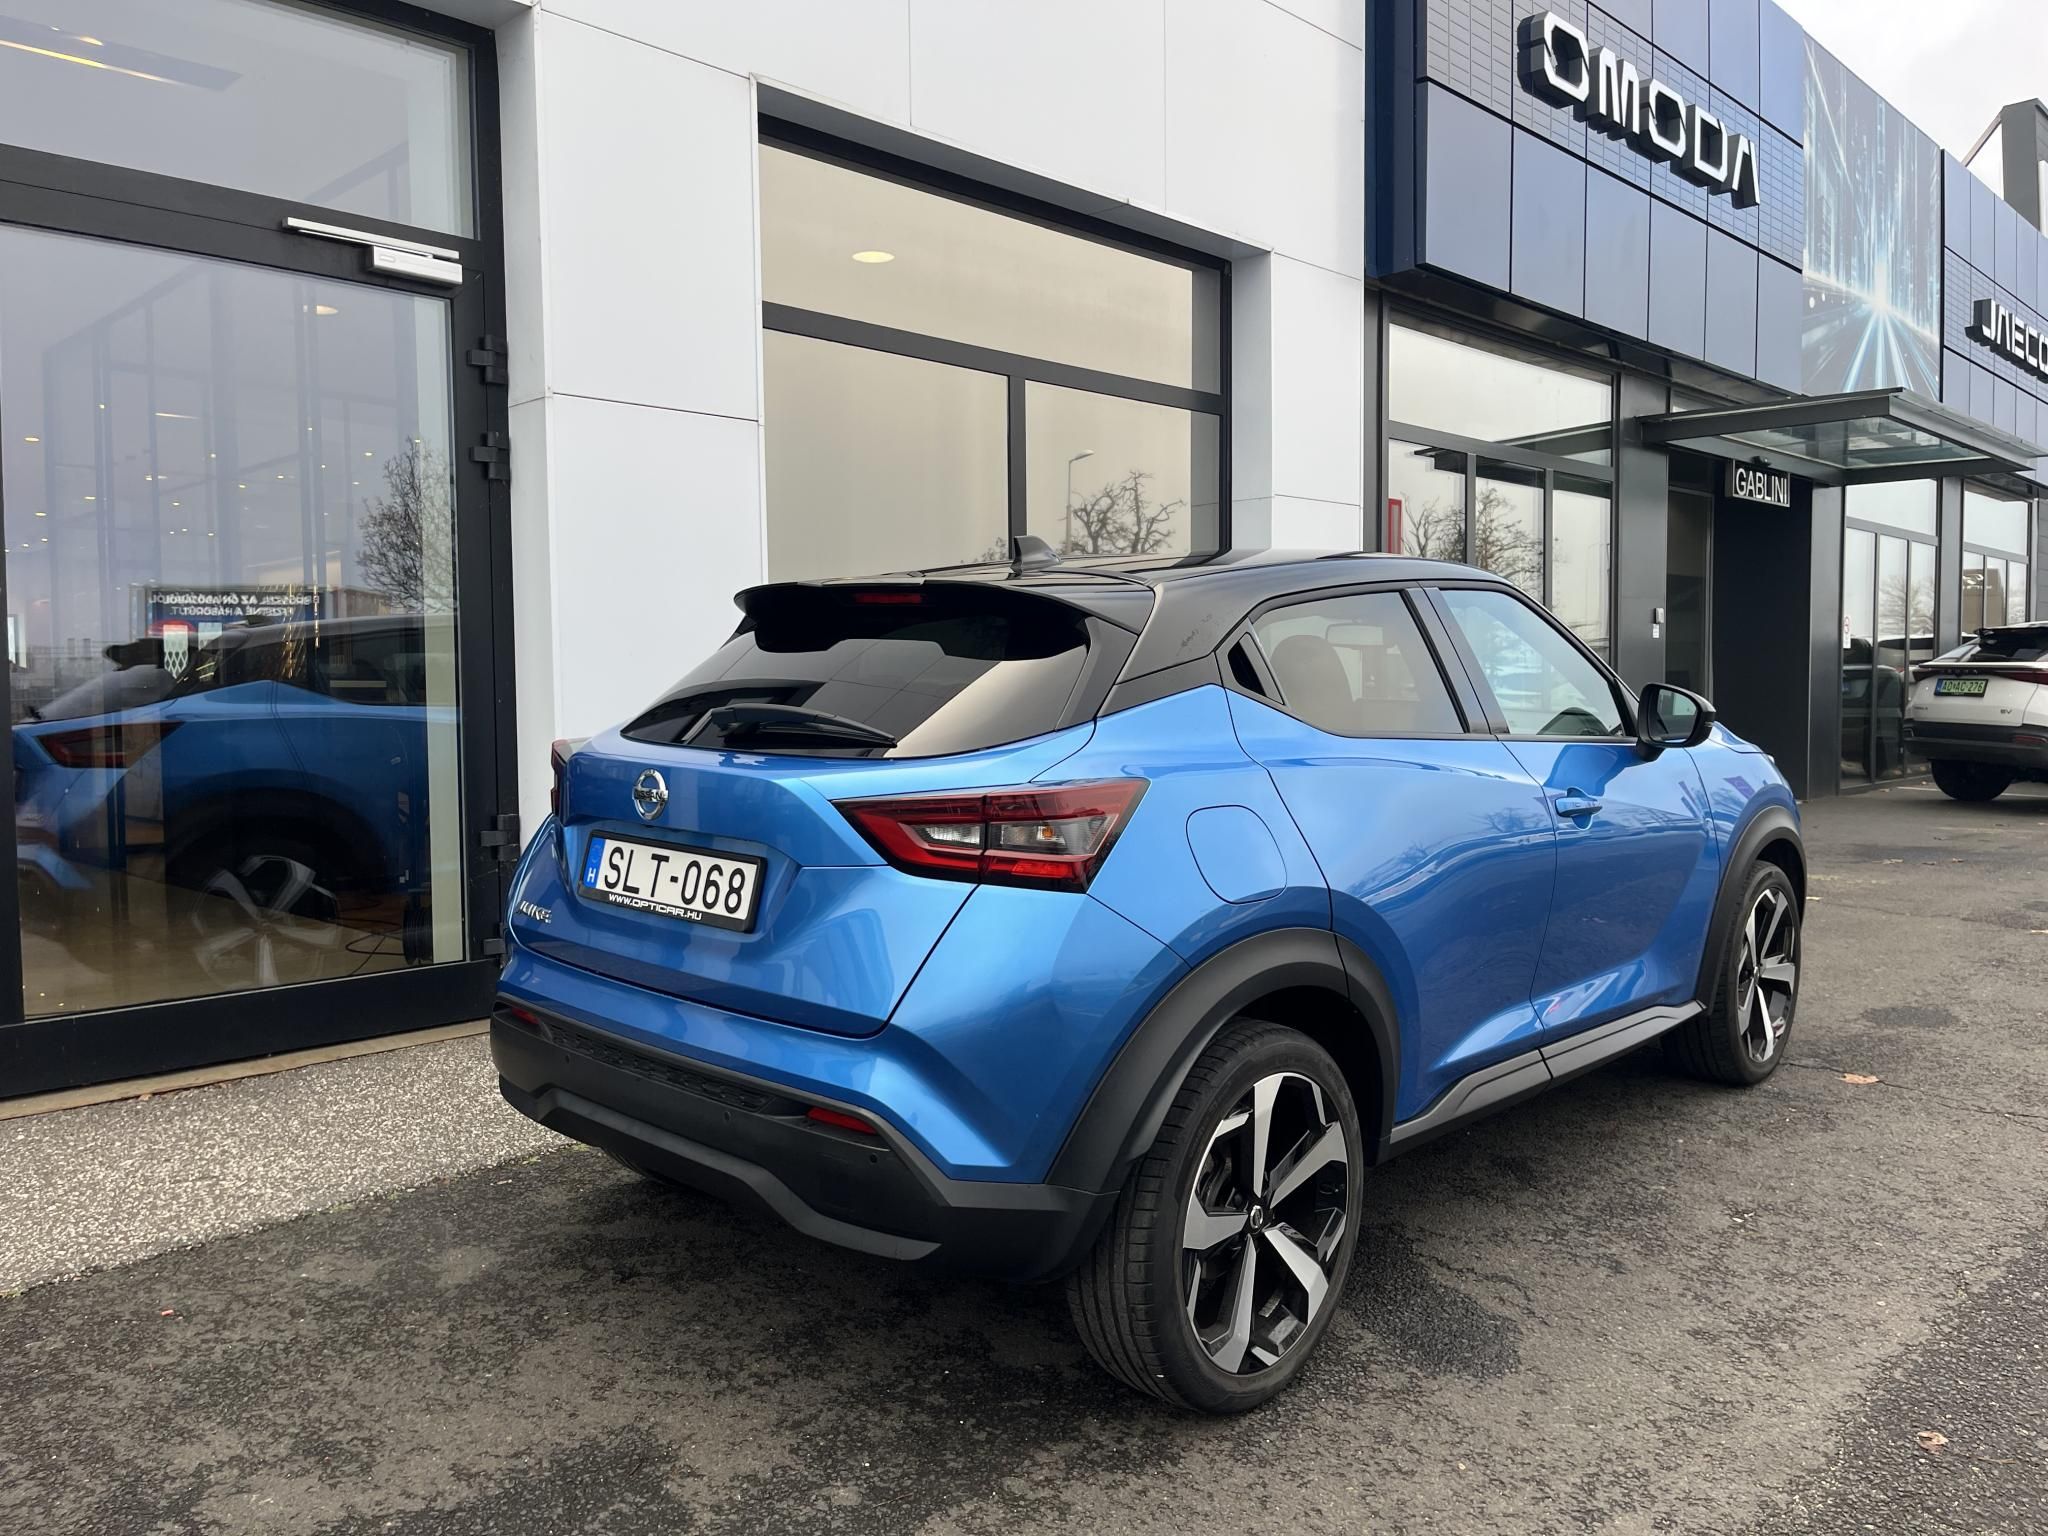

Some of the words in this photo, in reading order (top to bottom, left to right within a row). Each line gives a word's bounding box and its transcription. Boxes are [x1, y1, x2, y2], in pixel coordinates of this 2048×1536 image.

[1543, 11, 1760, 206] OMODA
[1736, 468, 1787, 505] GABLINI
[586, 867, 597, 883] H
[604, 846, 745, 914] SLT-068
[608, 893, 703, 921] WWW.OPTICAR.HU
